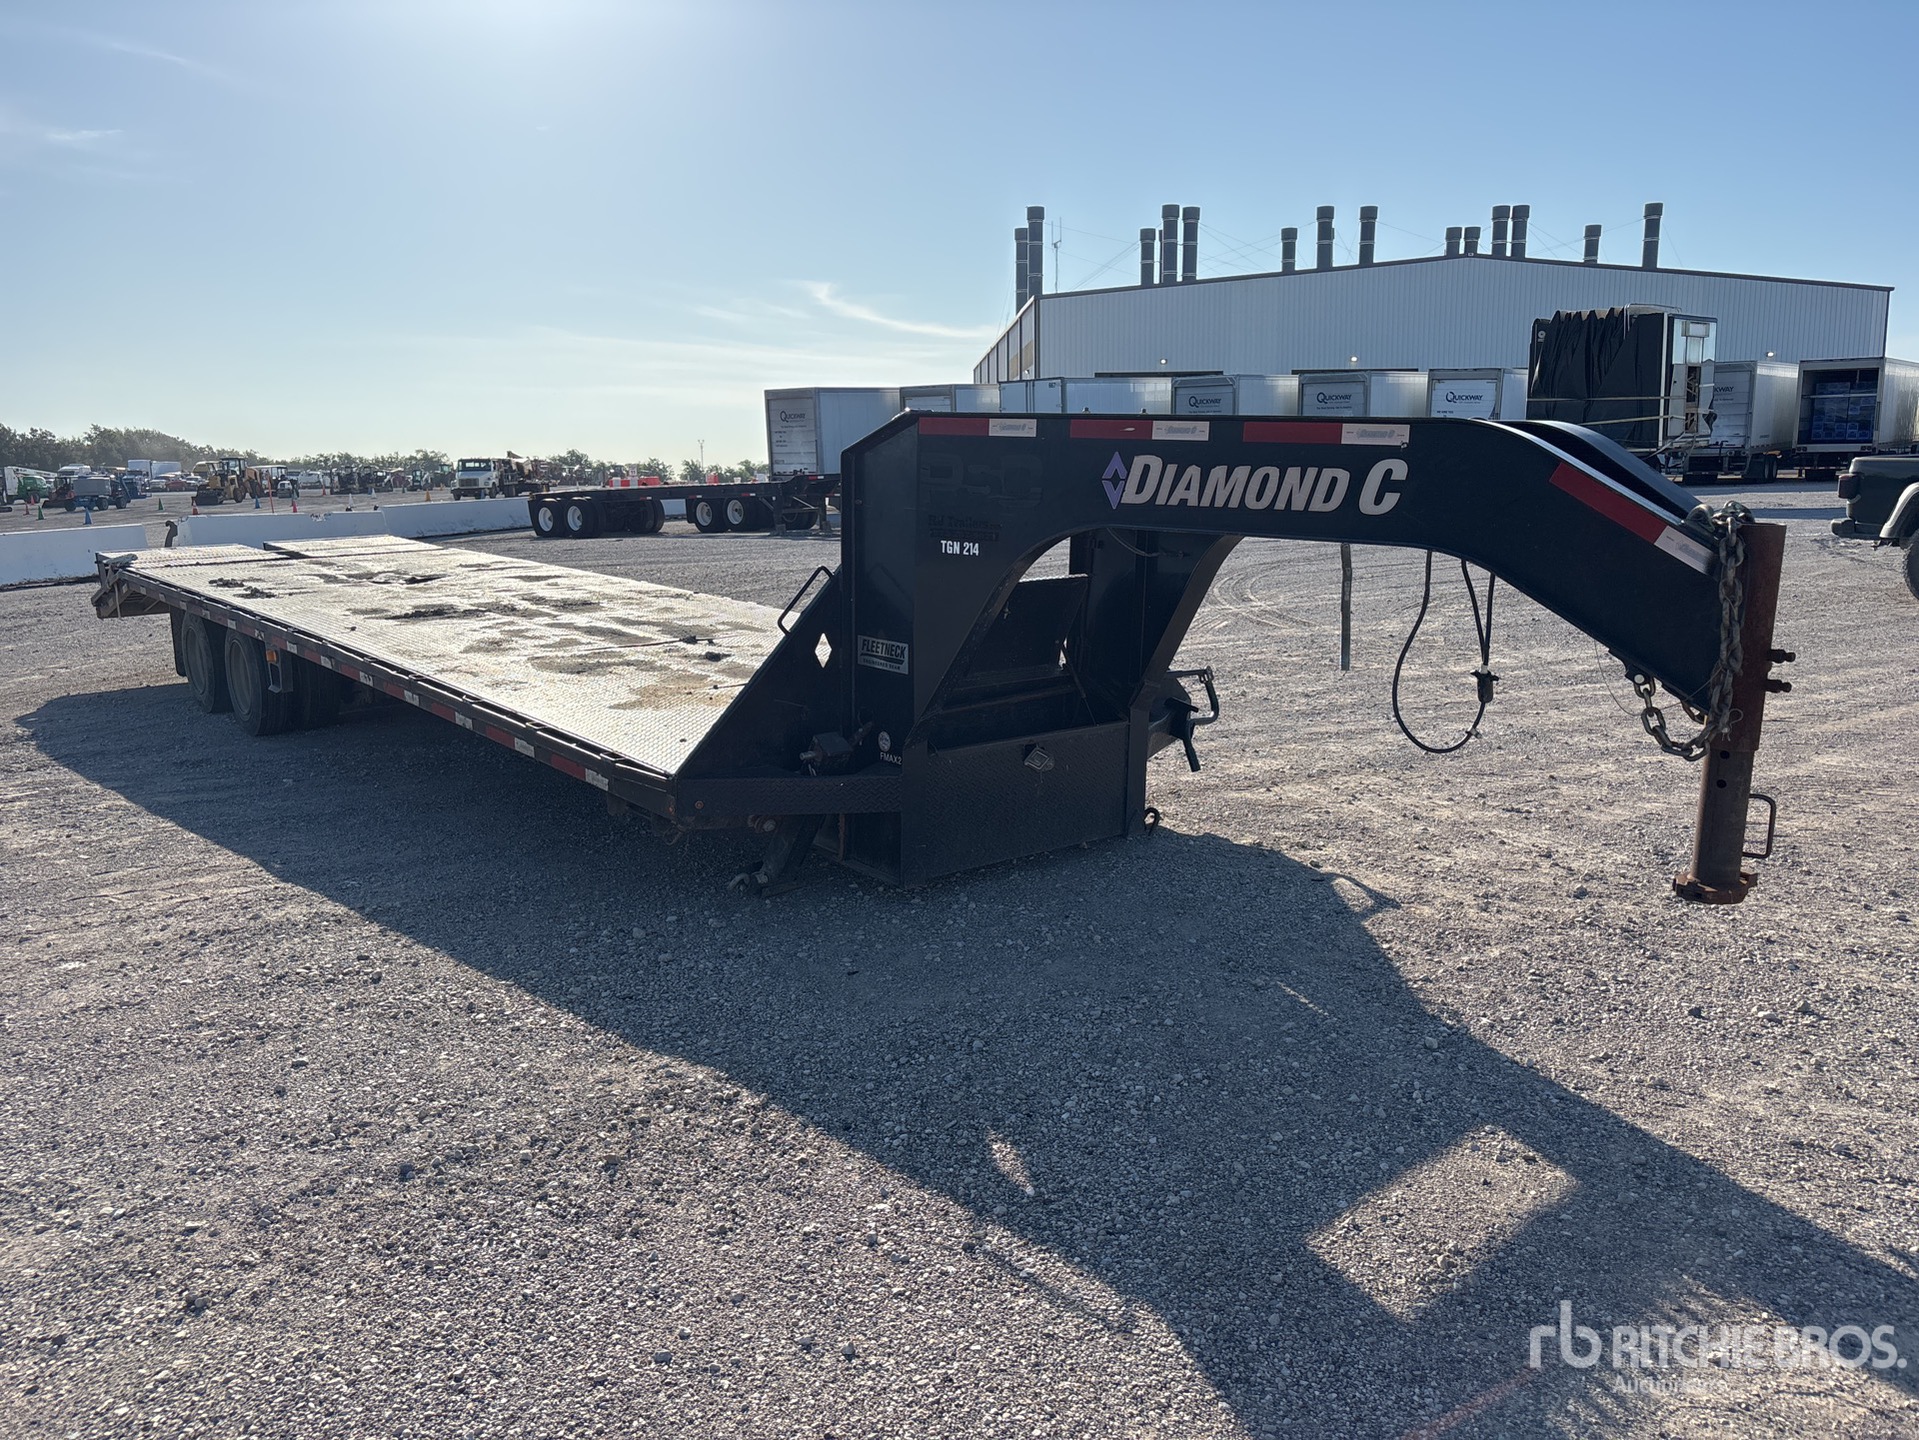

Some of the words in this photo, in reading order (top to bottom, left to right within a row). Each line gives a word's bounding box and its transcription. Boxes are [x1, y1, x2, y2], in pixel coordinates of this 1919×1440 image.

[1188, 395, 1222, 408] QUICKWAY
[1316, 391, 1352, 404] QUICKWAY
[1446, 391, 1484, 404] QUICKWAY
[1120, 454, 1350, 512] DIAMOND
[1358, 458, 1408, 515] C
[940, 540, 960, 554] TGN
[963, 541, 980, 556] 214
[861, 638, 906, 659] FLEETNECK
[879, 751, 902, 765] FMAX2
